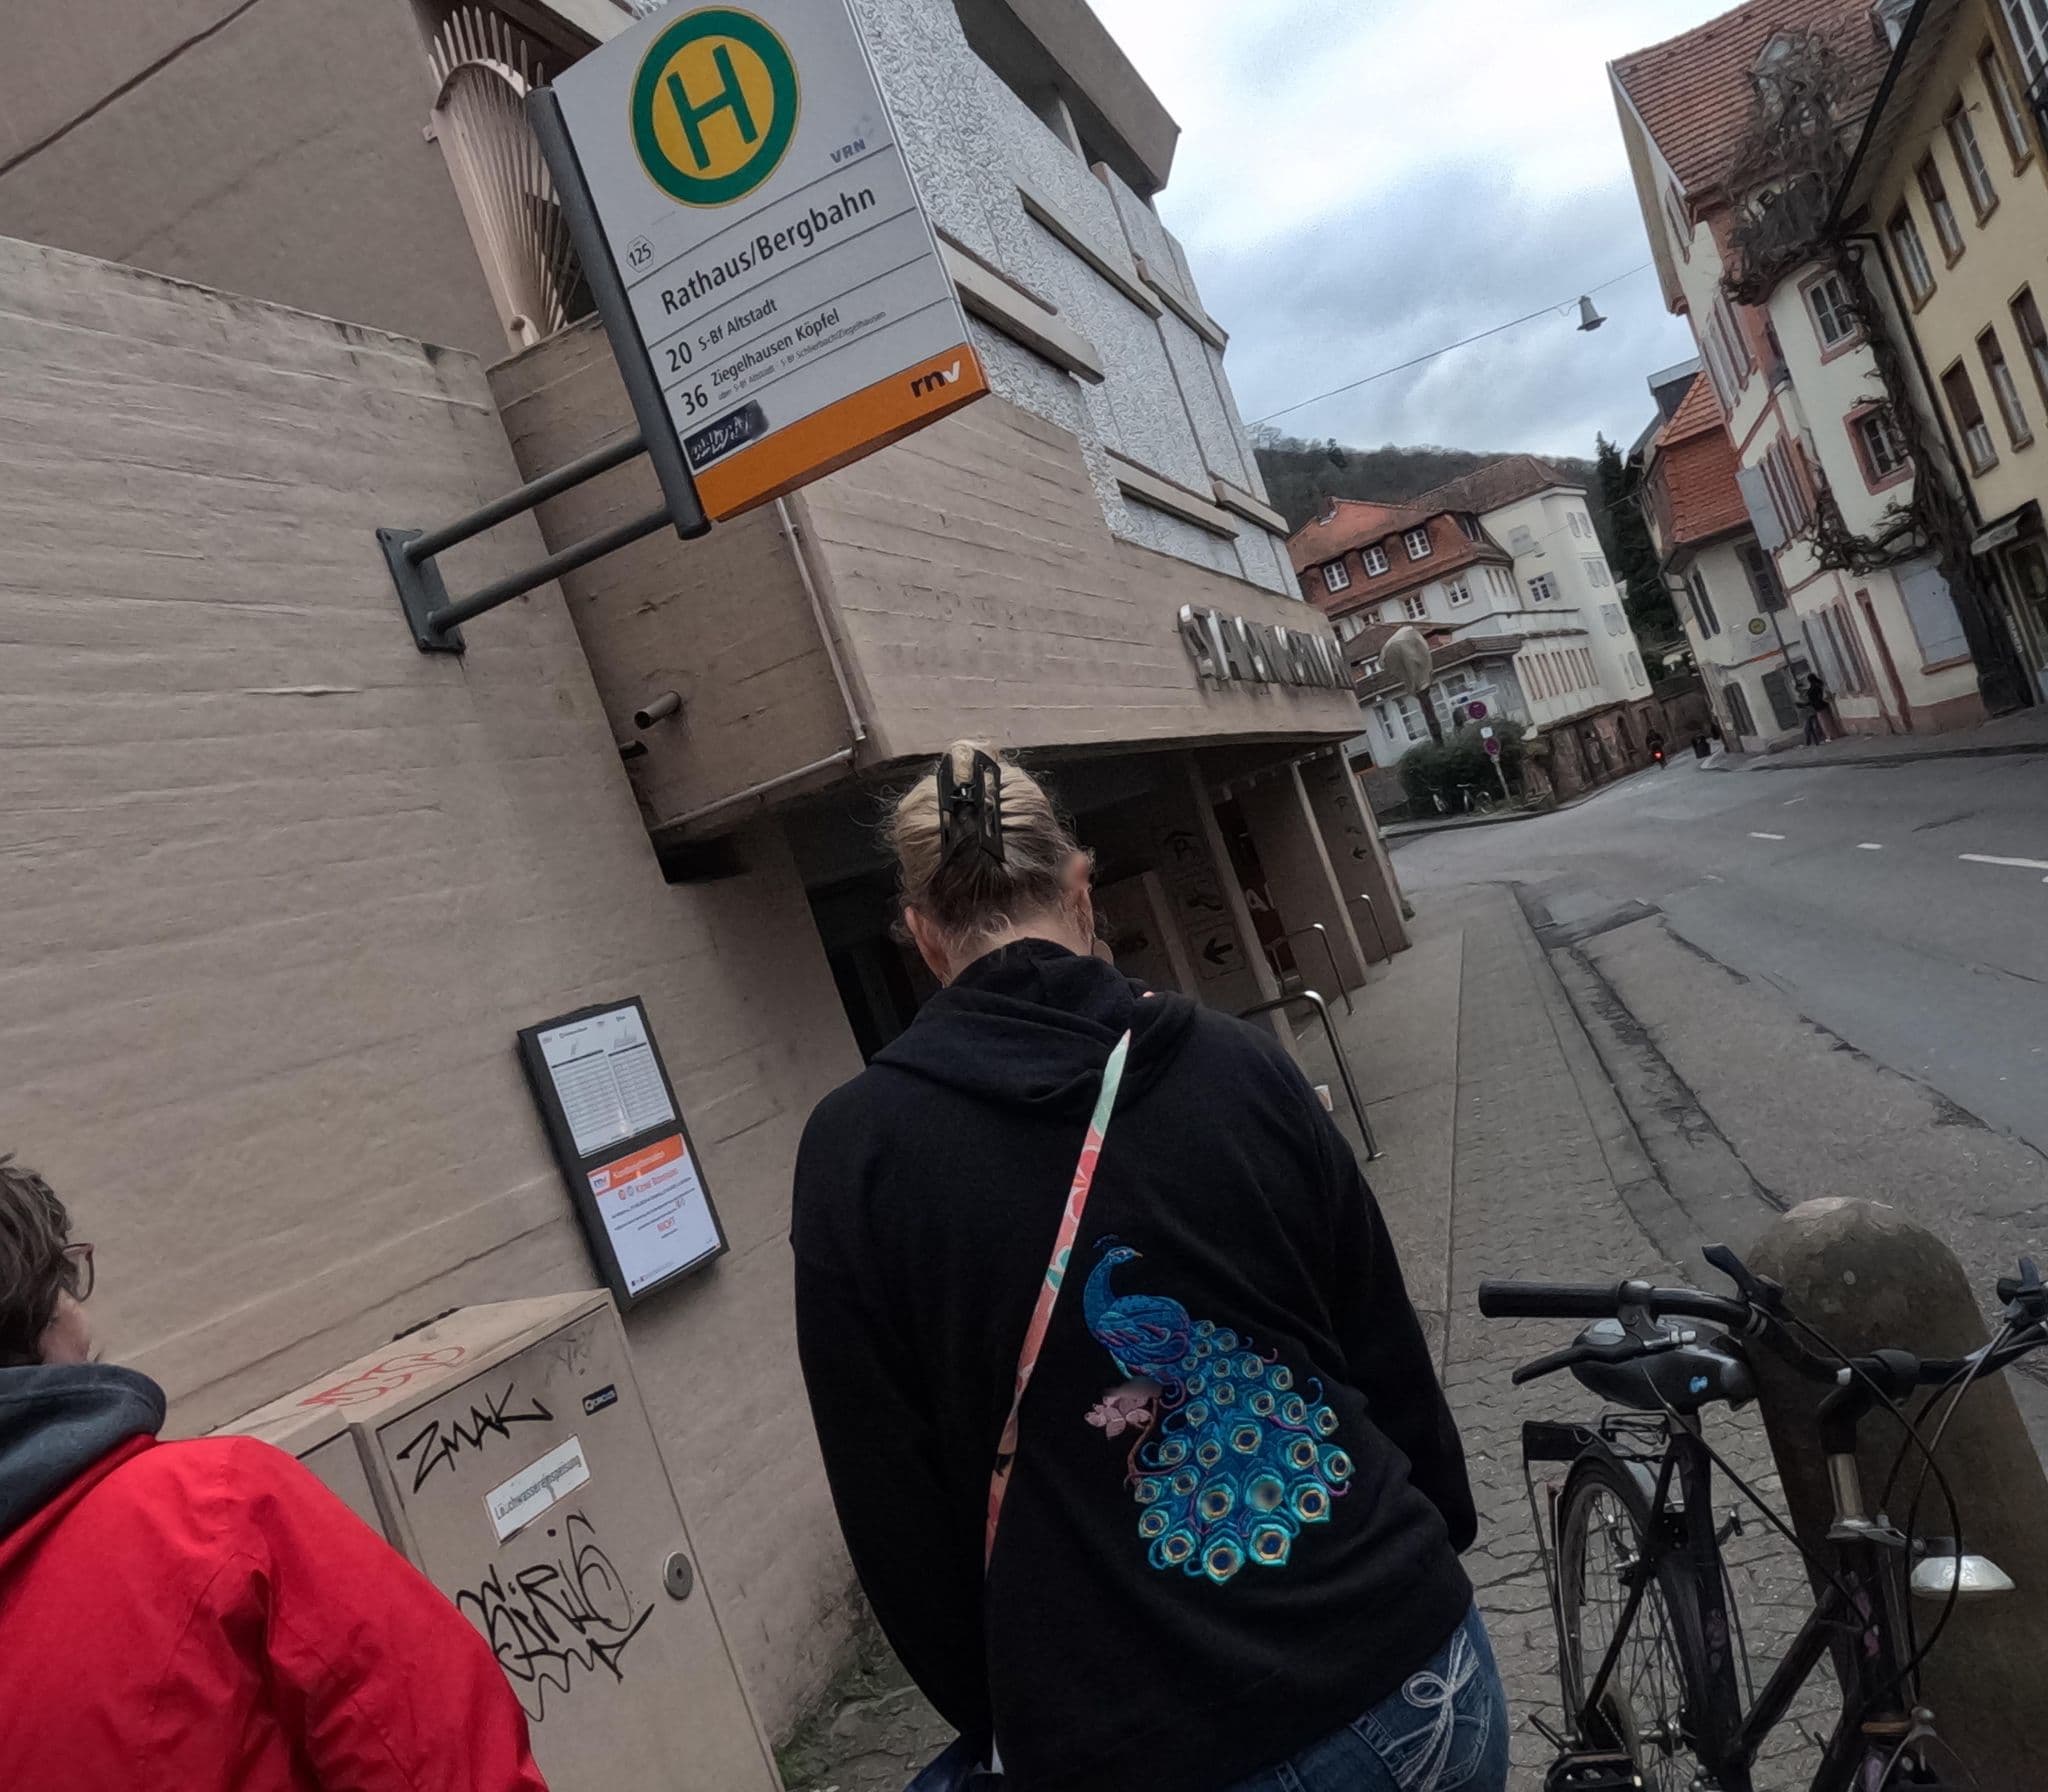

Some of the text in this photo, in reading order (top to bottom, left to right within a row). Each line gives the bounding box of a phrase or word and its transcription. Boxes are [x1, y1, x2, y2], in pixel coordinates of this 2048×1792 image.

[666, 44, 758, 171] H
[830, 138, 866, 163] VRN
[629, 243, 651, 266] 125
[660, 187, 876, 316] Rathaus/Bergbahn
[665, 299, 778, 373] 20 S-Bf Altstadt
[681, 308, 841, 416] 36 Ziegelhausen Köpfel
[910, 360, 960, 397] rnv
